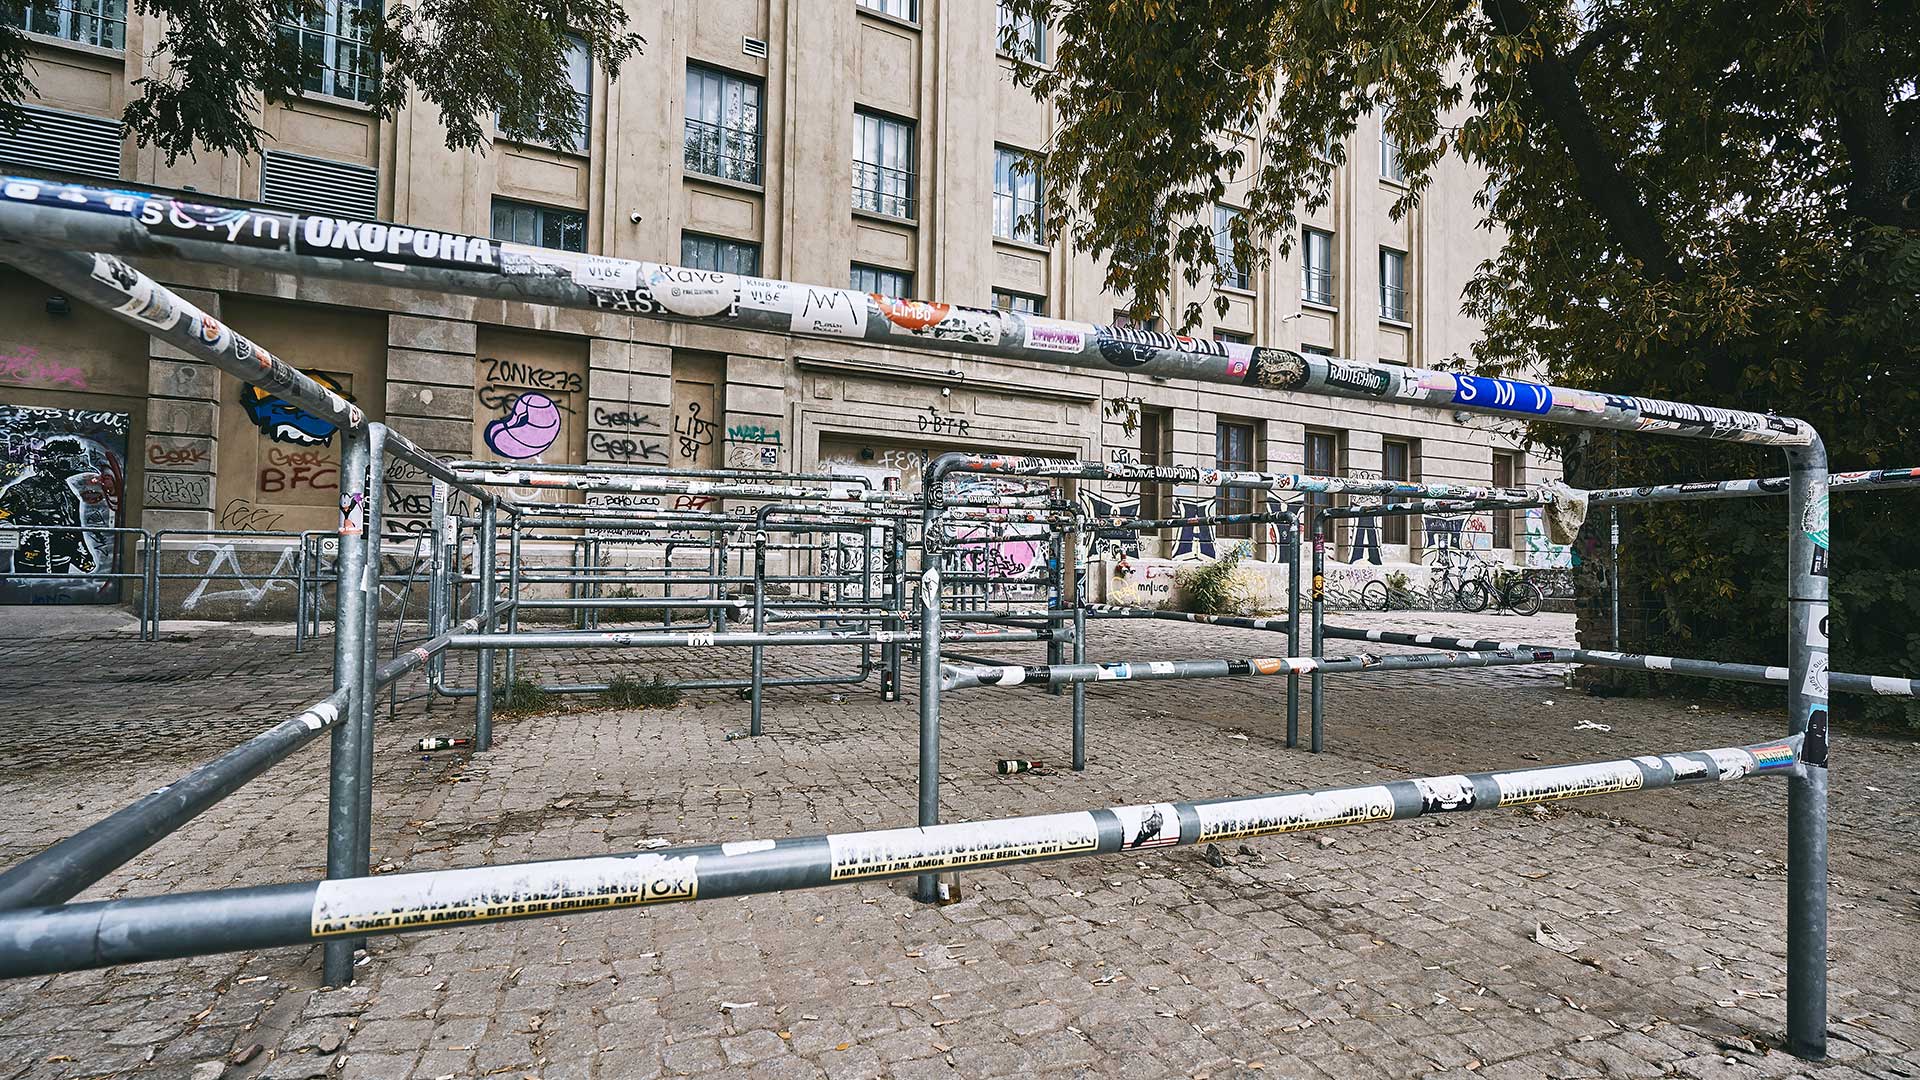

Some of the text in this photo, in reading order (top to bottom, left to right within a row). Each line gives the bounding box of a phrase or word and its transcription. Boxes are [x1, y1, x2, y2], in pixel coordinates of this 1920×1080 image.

[659, 264, 724, 284] Rave
[892, 302, 931, 322] LIMBO
[261, 468, 338, 493] BFC
[1370, 805, 1388, 817] OK
[858, 864, 886, 875] WHAT
[952, 855, 966, 864] DIT
[651, 878, 687, 896] OK
[512, 904, 525, 913] IS
[528, 902, 549, 913] DIE
[551, 897, 610, 911] BERLINER
[613, 894, 639, 905] ART
